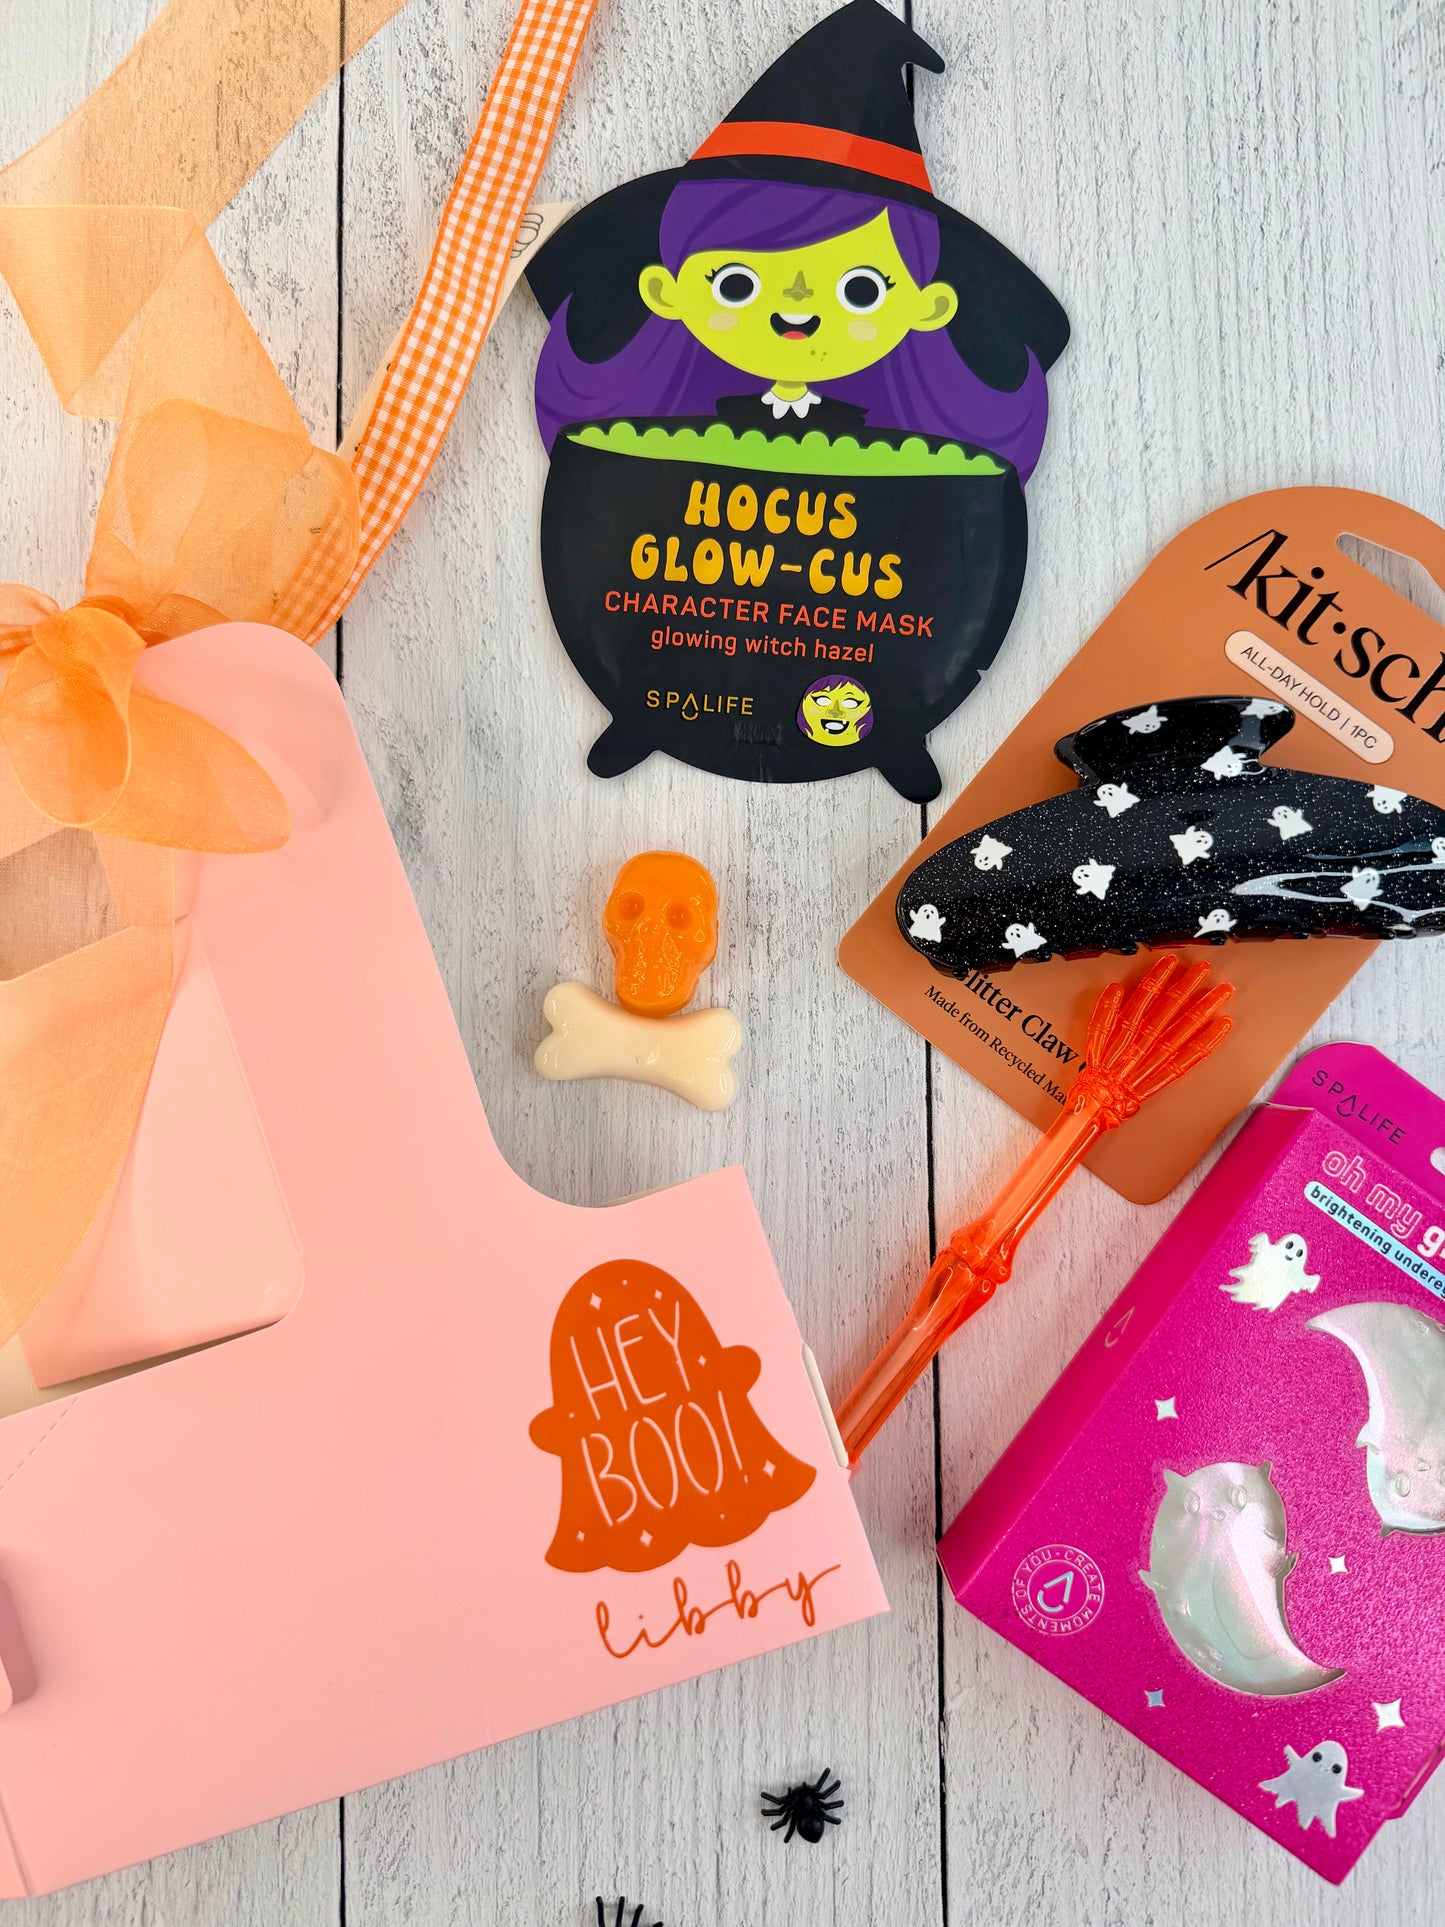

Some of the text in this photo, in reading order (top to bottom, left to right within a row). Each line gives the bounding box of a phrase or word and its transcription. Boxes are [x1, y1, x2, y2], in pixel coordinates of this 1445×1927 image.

[684, 480, 858, 540] HOCUS
[630, 532, 904, 601] GLOW-CUS
[604, 590, 936, 638] CHARACTER FACE MASK
[650, 625, 874, 663] glowing witch hazel
[646, 689, 754, 721] SPALIFE
[1240, 646, 1302, 691] ALL-DAY
[1298, 686, 1341, 723] HOLD
[1350, 724, 1378, 749] 1PC
[924, 985, 961, 1018] Made
[958, 1012, 991, 1043] from
[988, 1036, 1047, 1086] Recycled
[955, 970, 1079, 1065] litter Claw
[1311, 1069, 1407, 1146] SPALIFE
[1310, 1186, 1393, 1255] brightening
[1322, 1150, 1368, 1193] oh
[1365, 1183, 1423, 1239] my
[570, 1301, 691, 1421] HEY
[581, 1390, 749, 1527] BOO!
[596, 1559, 842, 1659] libby
[1015, 1549, 1102, 1632] CREATE MOMENTS OF YOU
